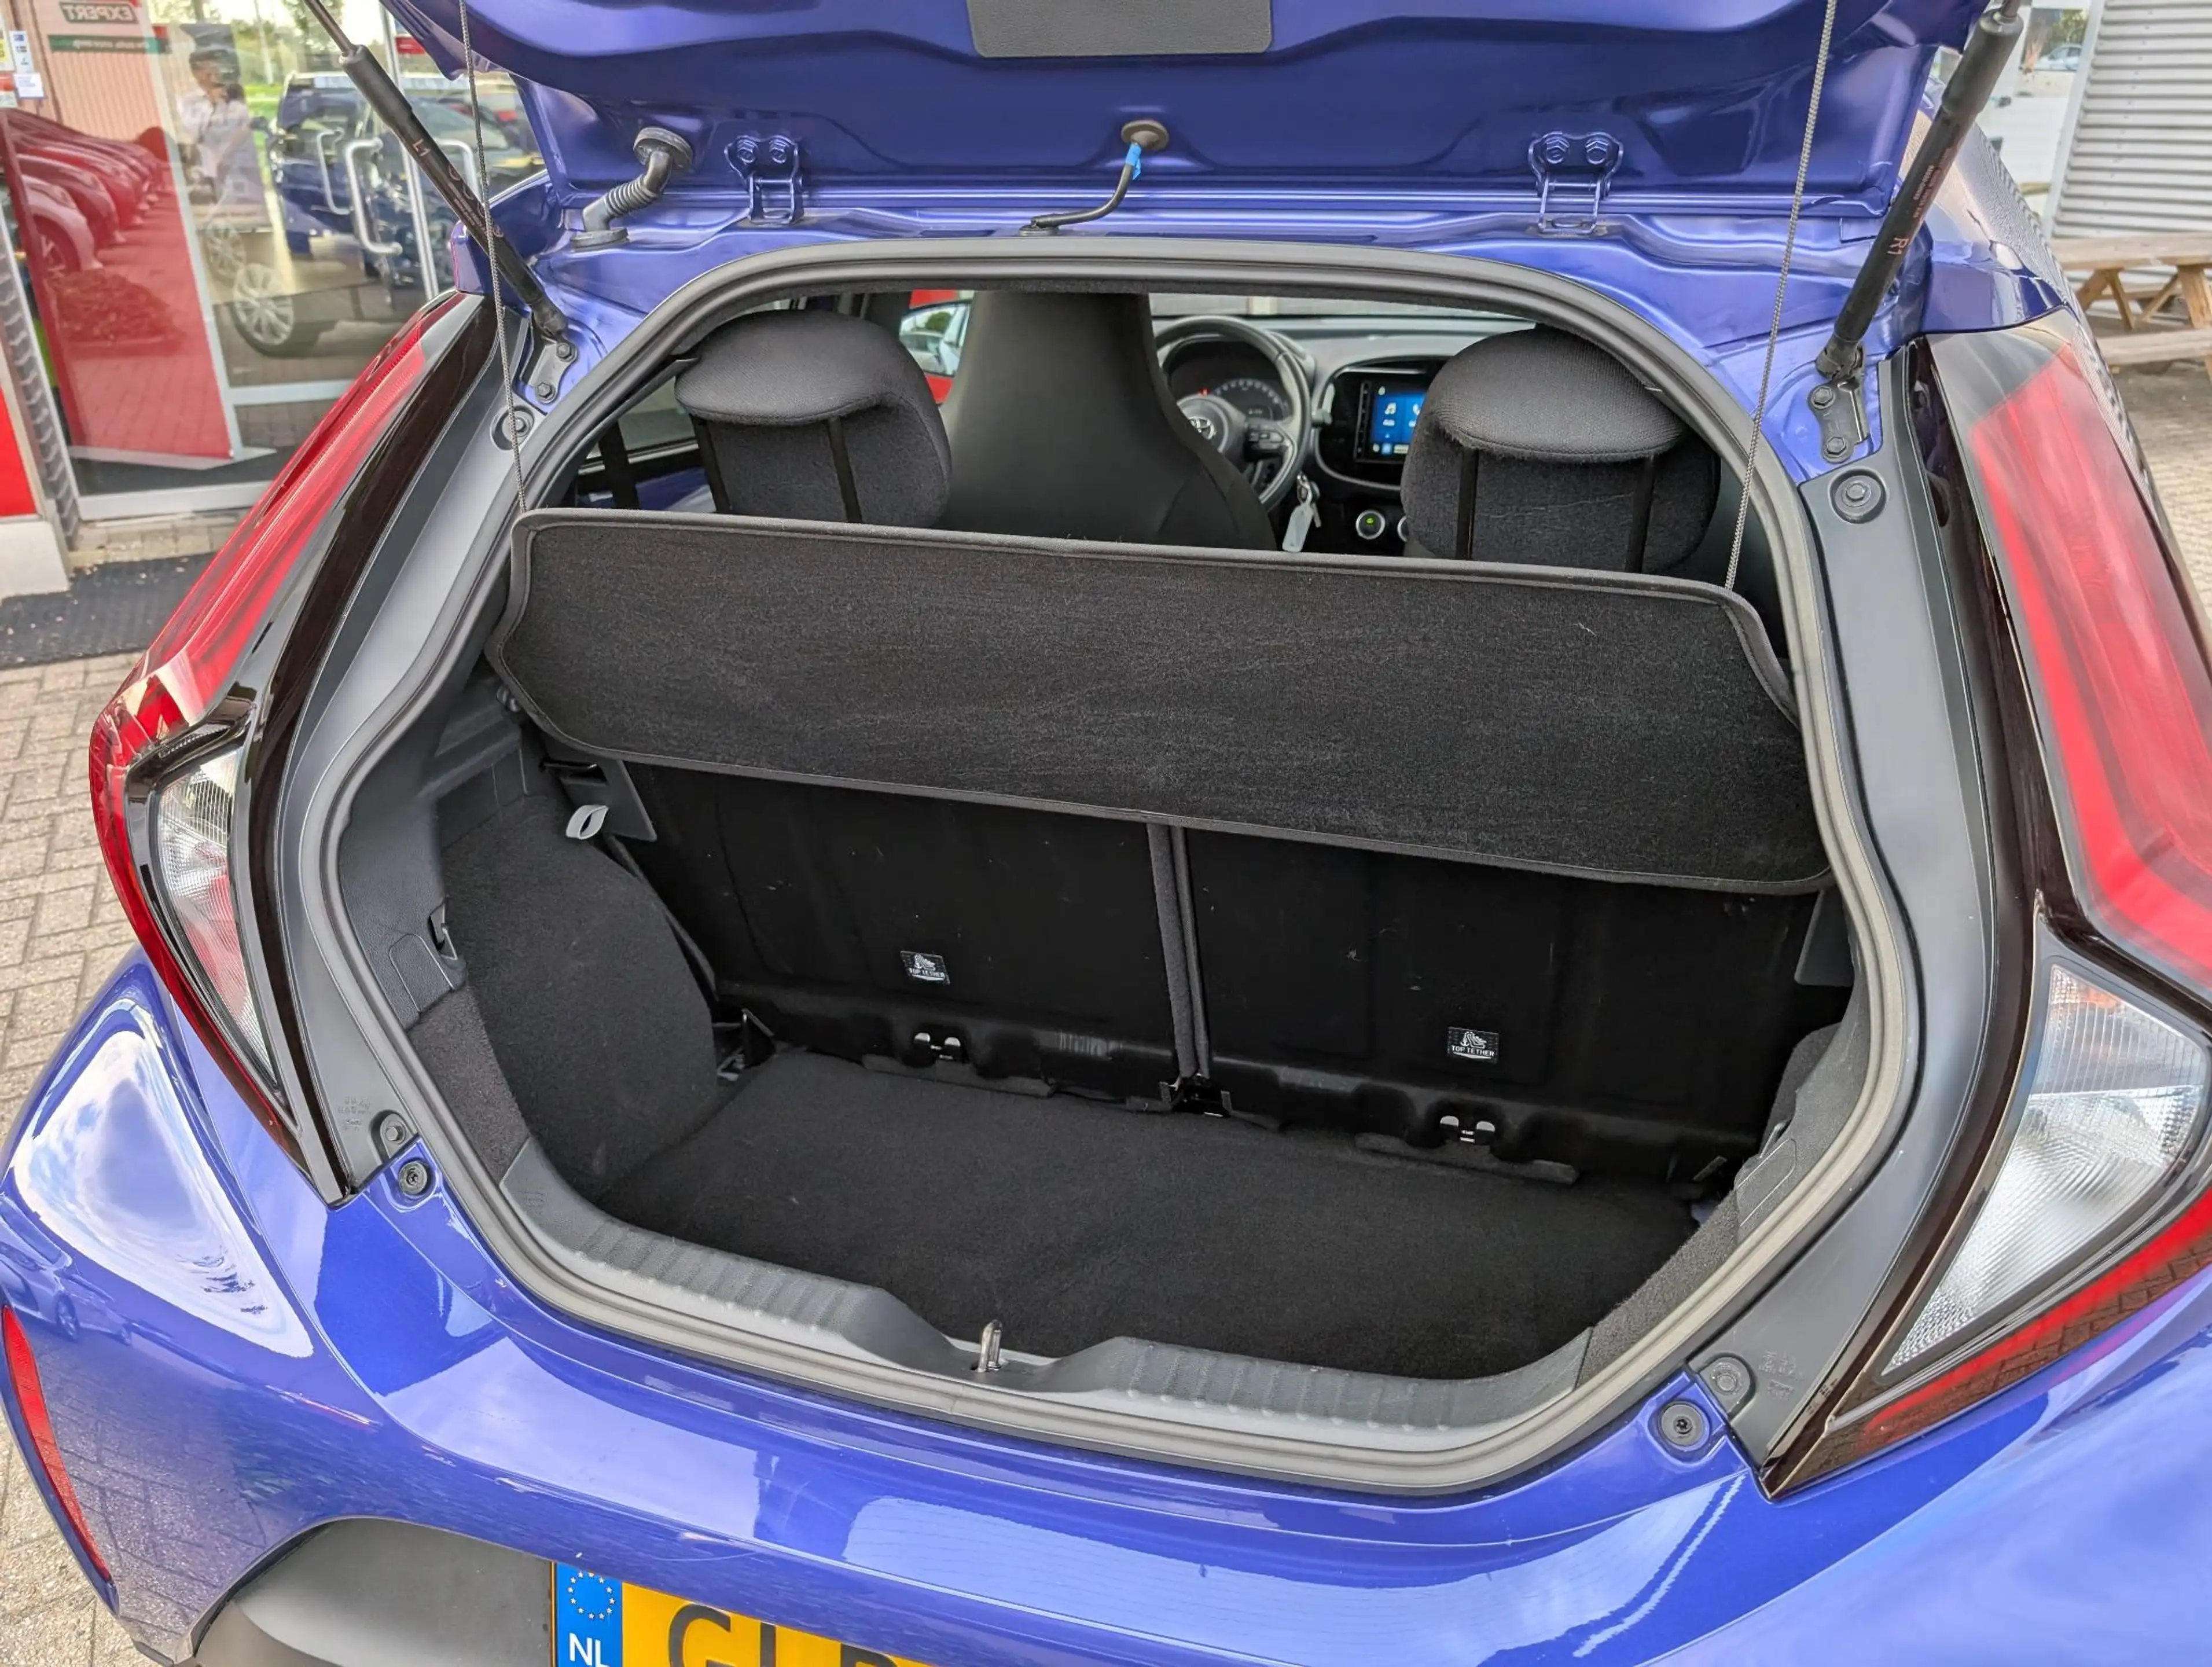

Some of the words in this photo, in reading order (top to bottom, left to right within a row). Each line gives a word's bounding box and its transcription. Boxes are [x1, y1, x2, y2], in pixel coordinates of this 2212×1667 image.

[1887, 237, 1909, 255] R1
[1467, 1048, 1494, 1056] TETHER
[569, 1632, 611, 1667] NL
